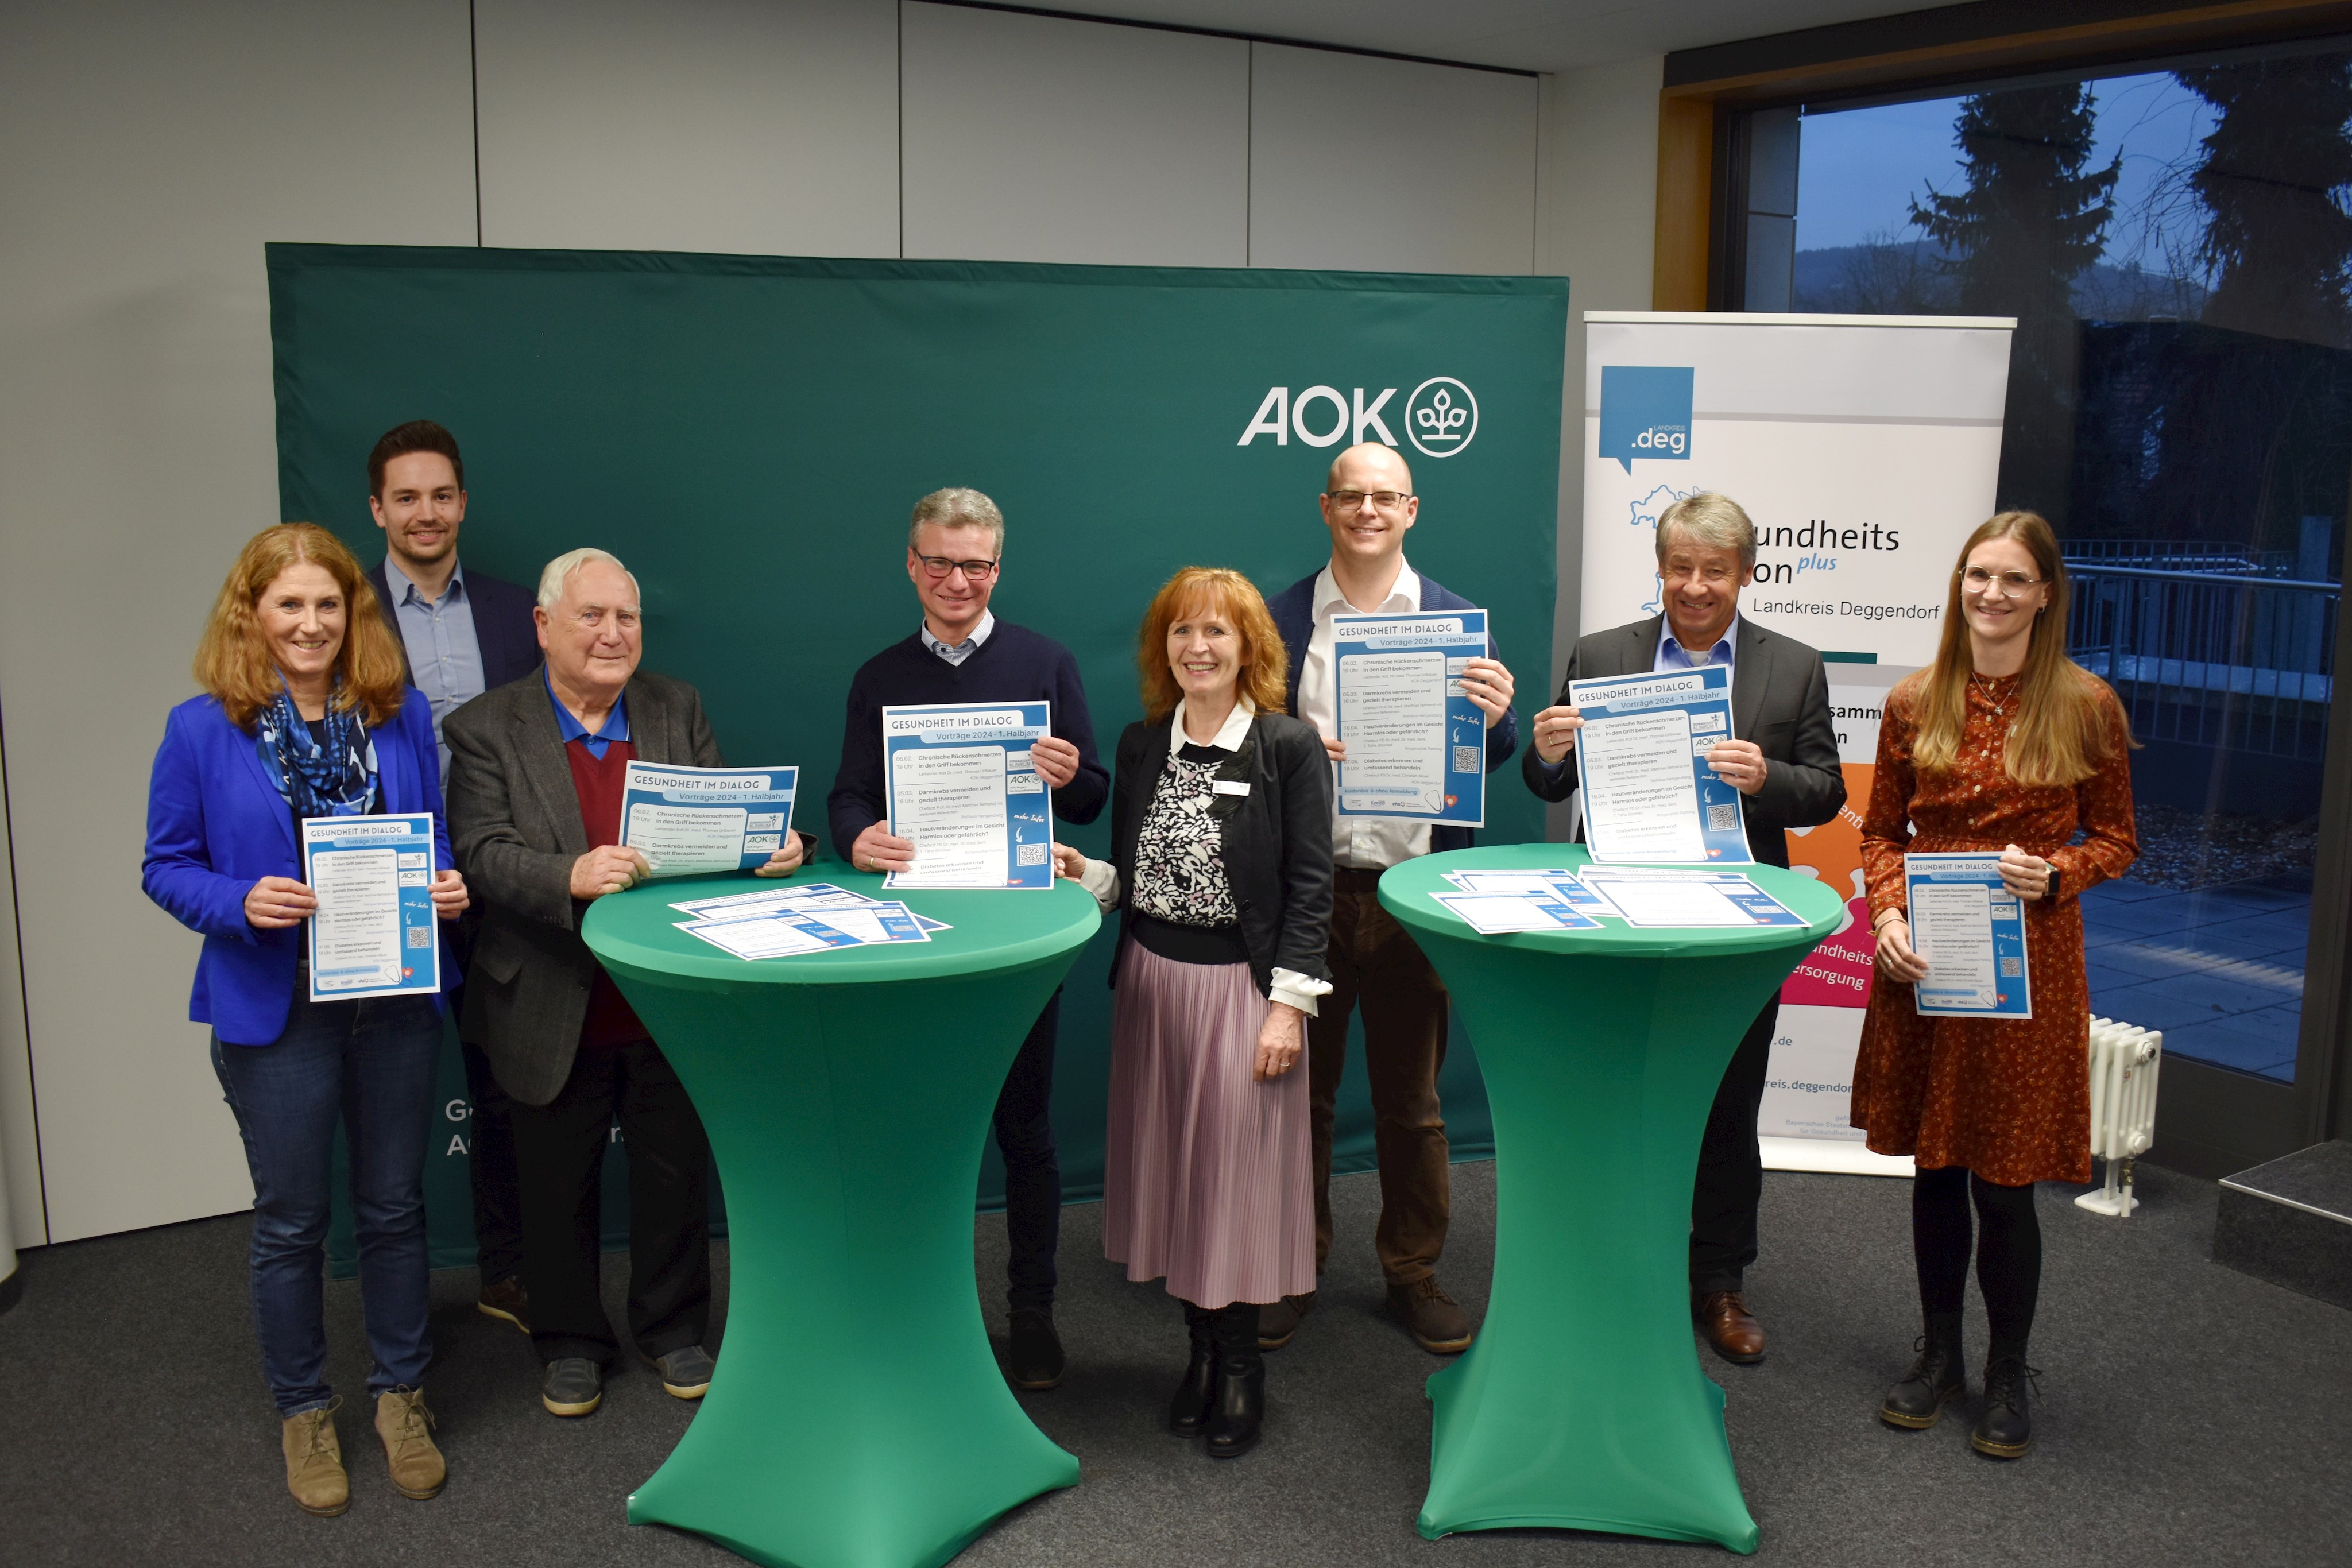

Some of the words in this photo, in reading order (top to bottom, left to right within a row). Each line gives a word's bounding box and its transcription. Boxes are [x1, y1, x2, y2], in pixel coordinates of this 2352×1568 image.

[1237, 385, 1399, 447] AOK
[1631, 428, 1685, 454] .deg
[1756, 520, 1900, 551] undheits
[1797, 553, 1837, 574] plus
[1753, 563, 1792, 584] on
[1753, 598, 1833, 615] Landkreis
[1840, 602, 1940, 620] Deggendorf
[1339, 627, 1398, 636] GESUNDHEIT
[1415, 624, 1452, 633] DIALOG
[1380, 638, 1413, 646] Vorträge
[1579, 688, 1638, 702] GESUNDHEIT
[1641, 687, 1651, 695] IM
[1656, 682, 1693, 692] DIALOG
[1621, 700, 1653, 709] Vorträge
[1688, 692, 1719, 701] Halbjahr
[1829, 707, 1882, 719] samm
[892, 719, 953, 729] GESUNDHEIT
[973, 717, 1012, 725] DIALOG
[635, 776, 701, 789] GESUNDHEIT
[705, 781, 716, 789] IM
[311, 828, 358, 837] GESUNDHEIT
[920, 824, 974, 833] Hautveränderungen
[398, 837, 423, 845] Halbjahr
[1765, 1079, 1852, 1093] reis.deggendor
